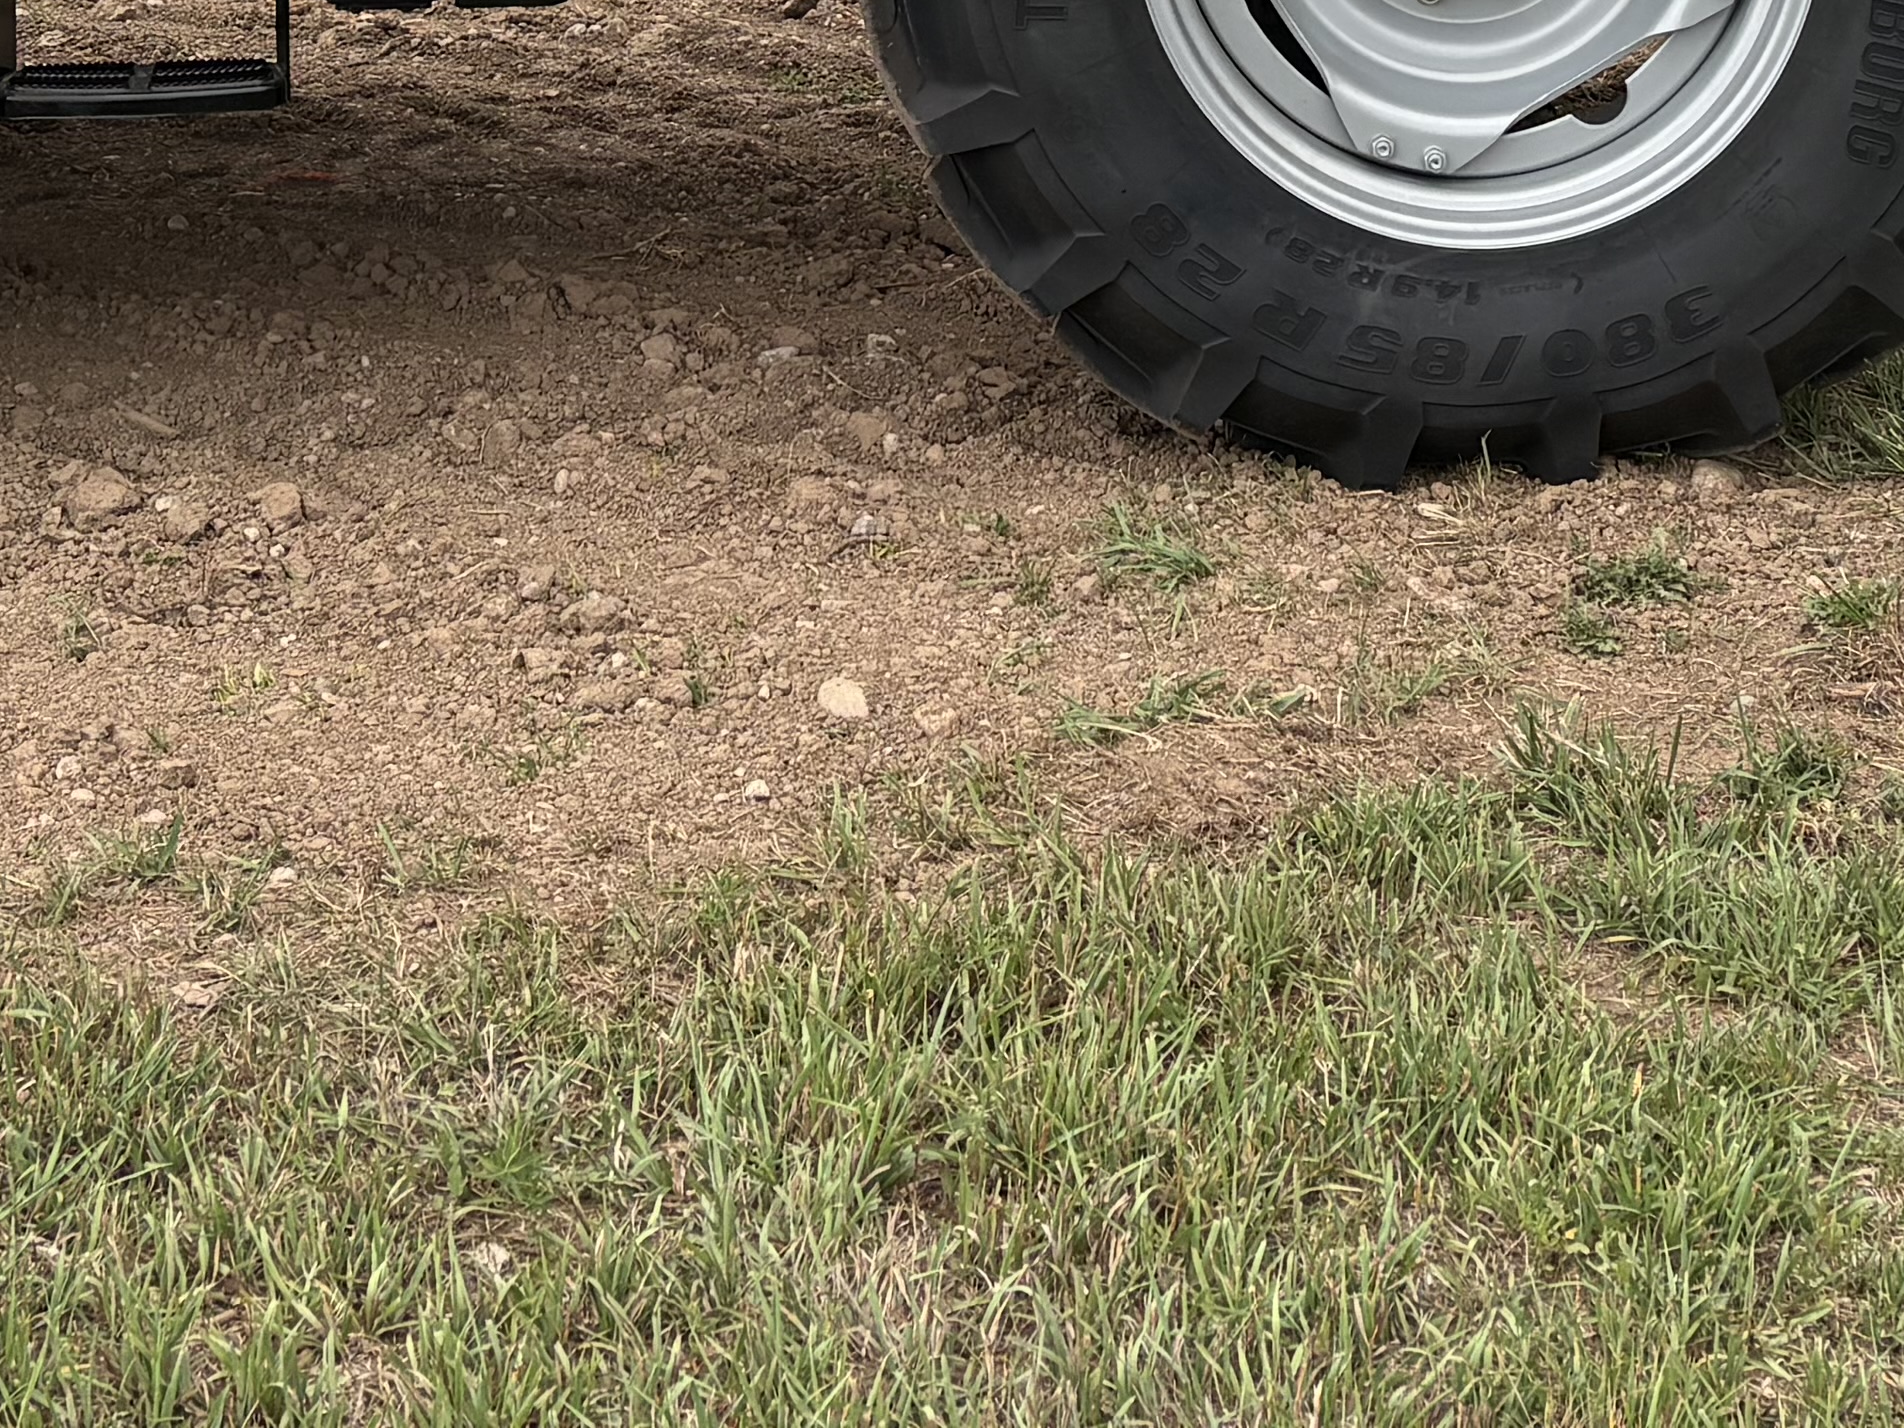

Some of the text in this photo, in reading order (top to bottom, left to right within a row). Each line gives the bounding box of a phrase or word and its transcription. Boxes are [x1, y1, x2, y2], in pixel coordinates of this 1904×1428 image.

[1128, 201, 1726, 387] 380/85 R 28
